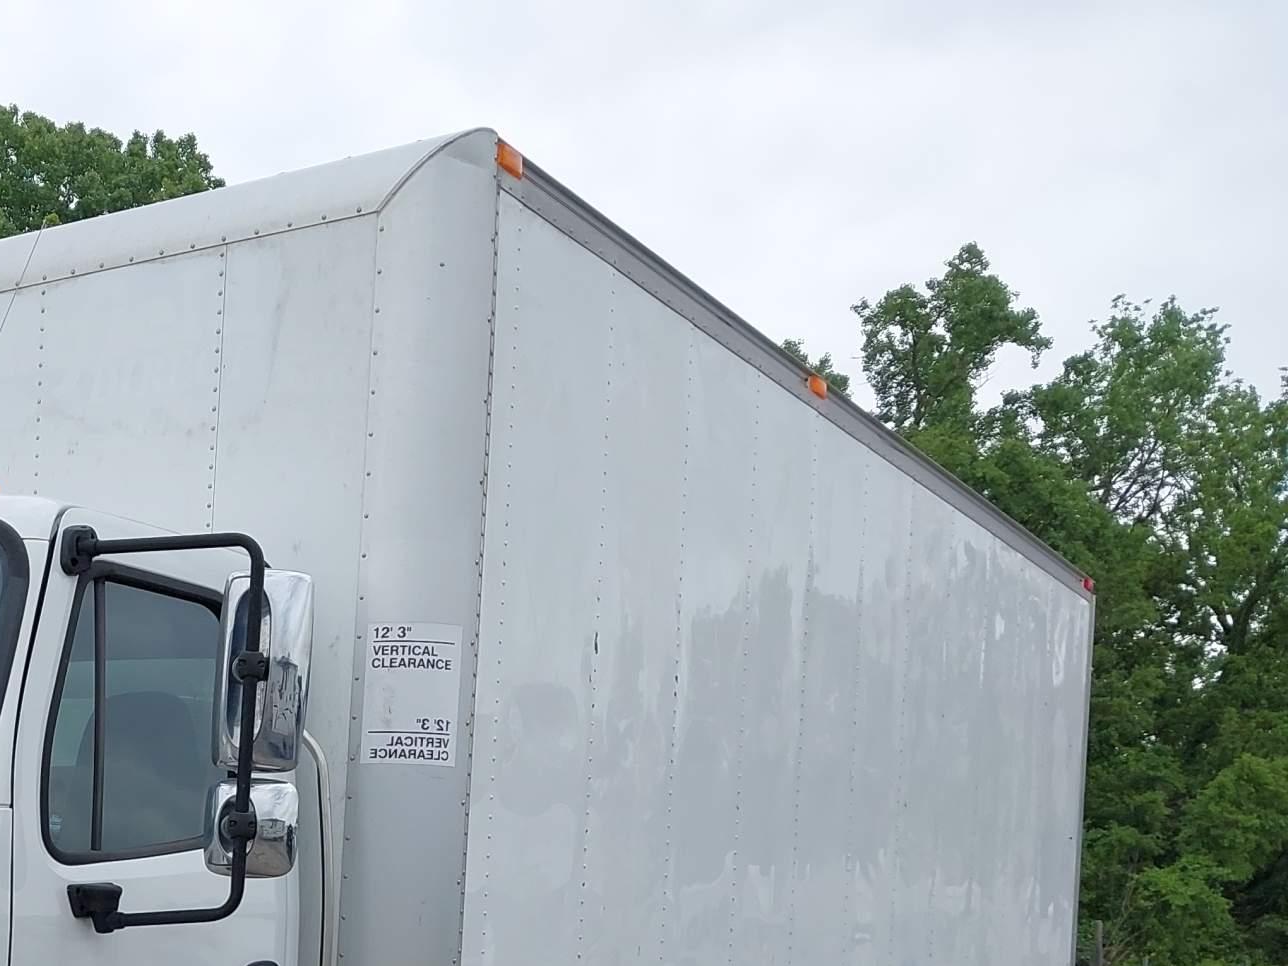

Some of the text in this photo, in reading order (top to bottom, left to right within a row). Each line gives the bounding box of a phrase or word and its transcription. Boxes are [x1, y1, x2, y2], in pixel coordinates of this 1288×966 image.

[373, 626, 412, 639] 12' 3"
[372, 644, 439, 657] VERTICAL
[371, 657, 452, 670] CLEARANCE
